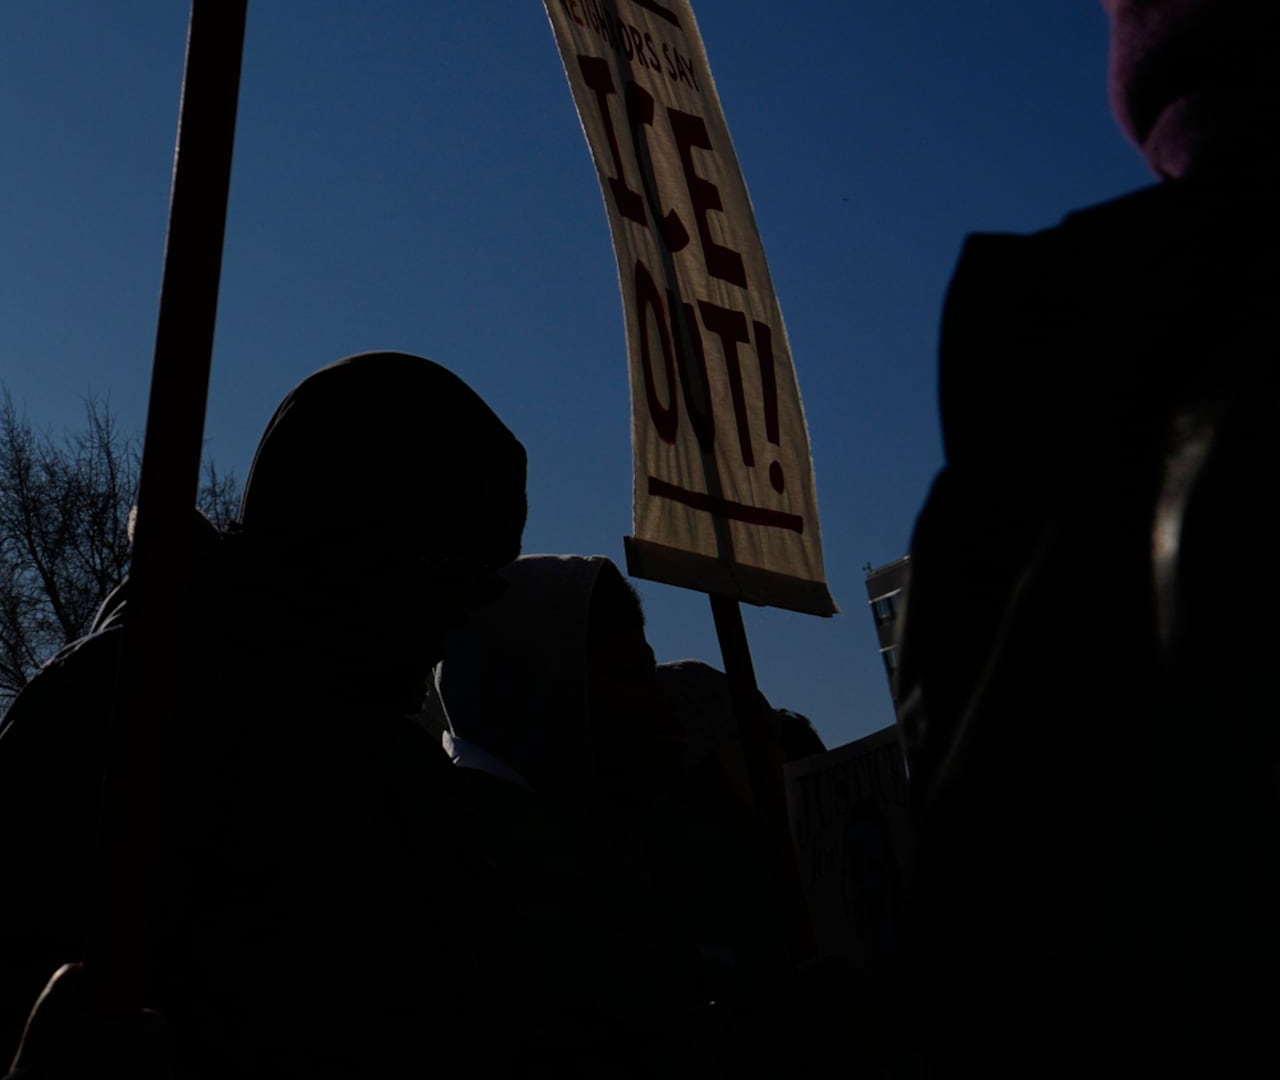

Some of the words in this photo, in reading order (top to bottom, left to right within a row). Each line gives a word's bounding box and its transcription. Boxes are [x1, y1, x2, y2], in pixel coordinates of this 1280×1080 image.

[578, 54, 748, 290] ICE
[662, 42, 700, 92] SAY
[635, 259, 786, 495] OUT!
